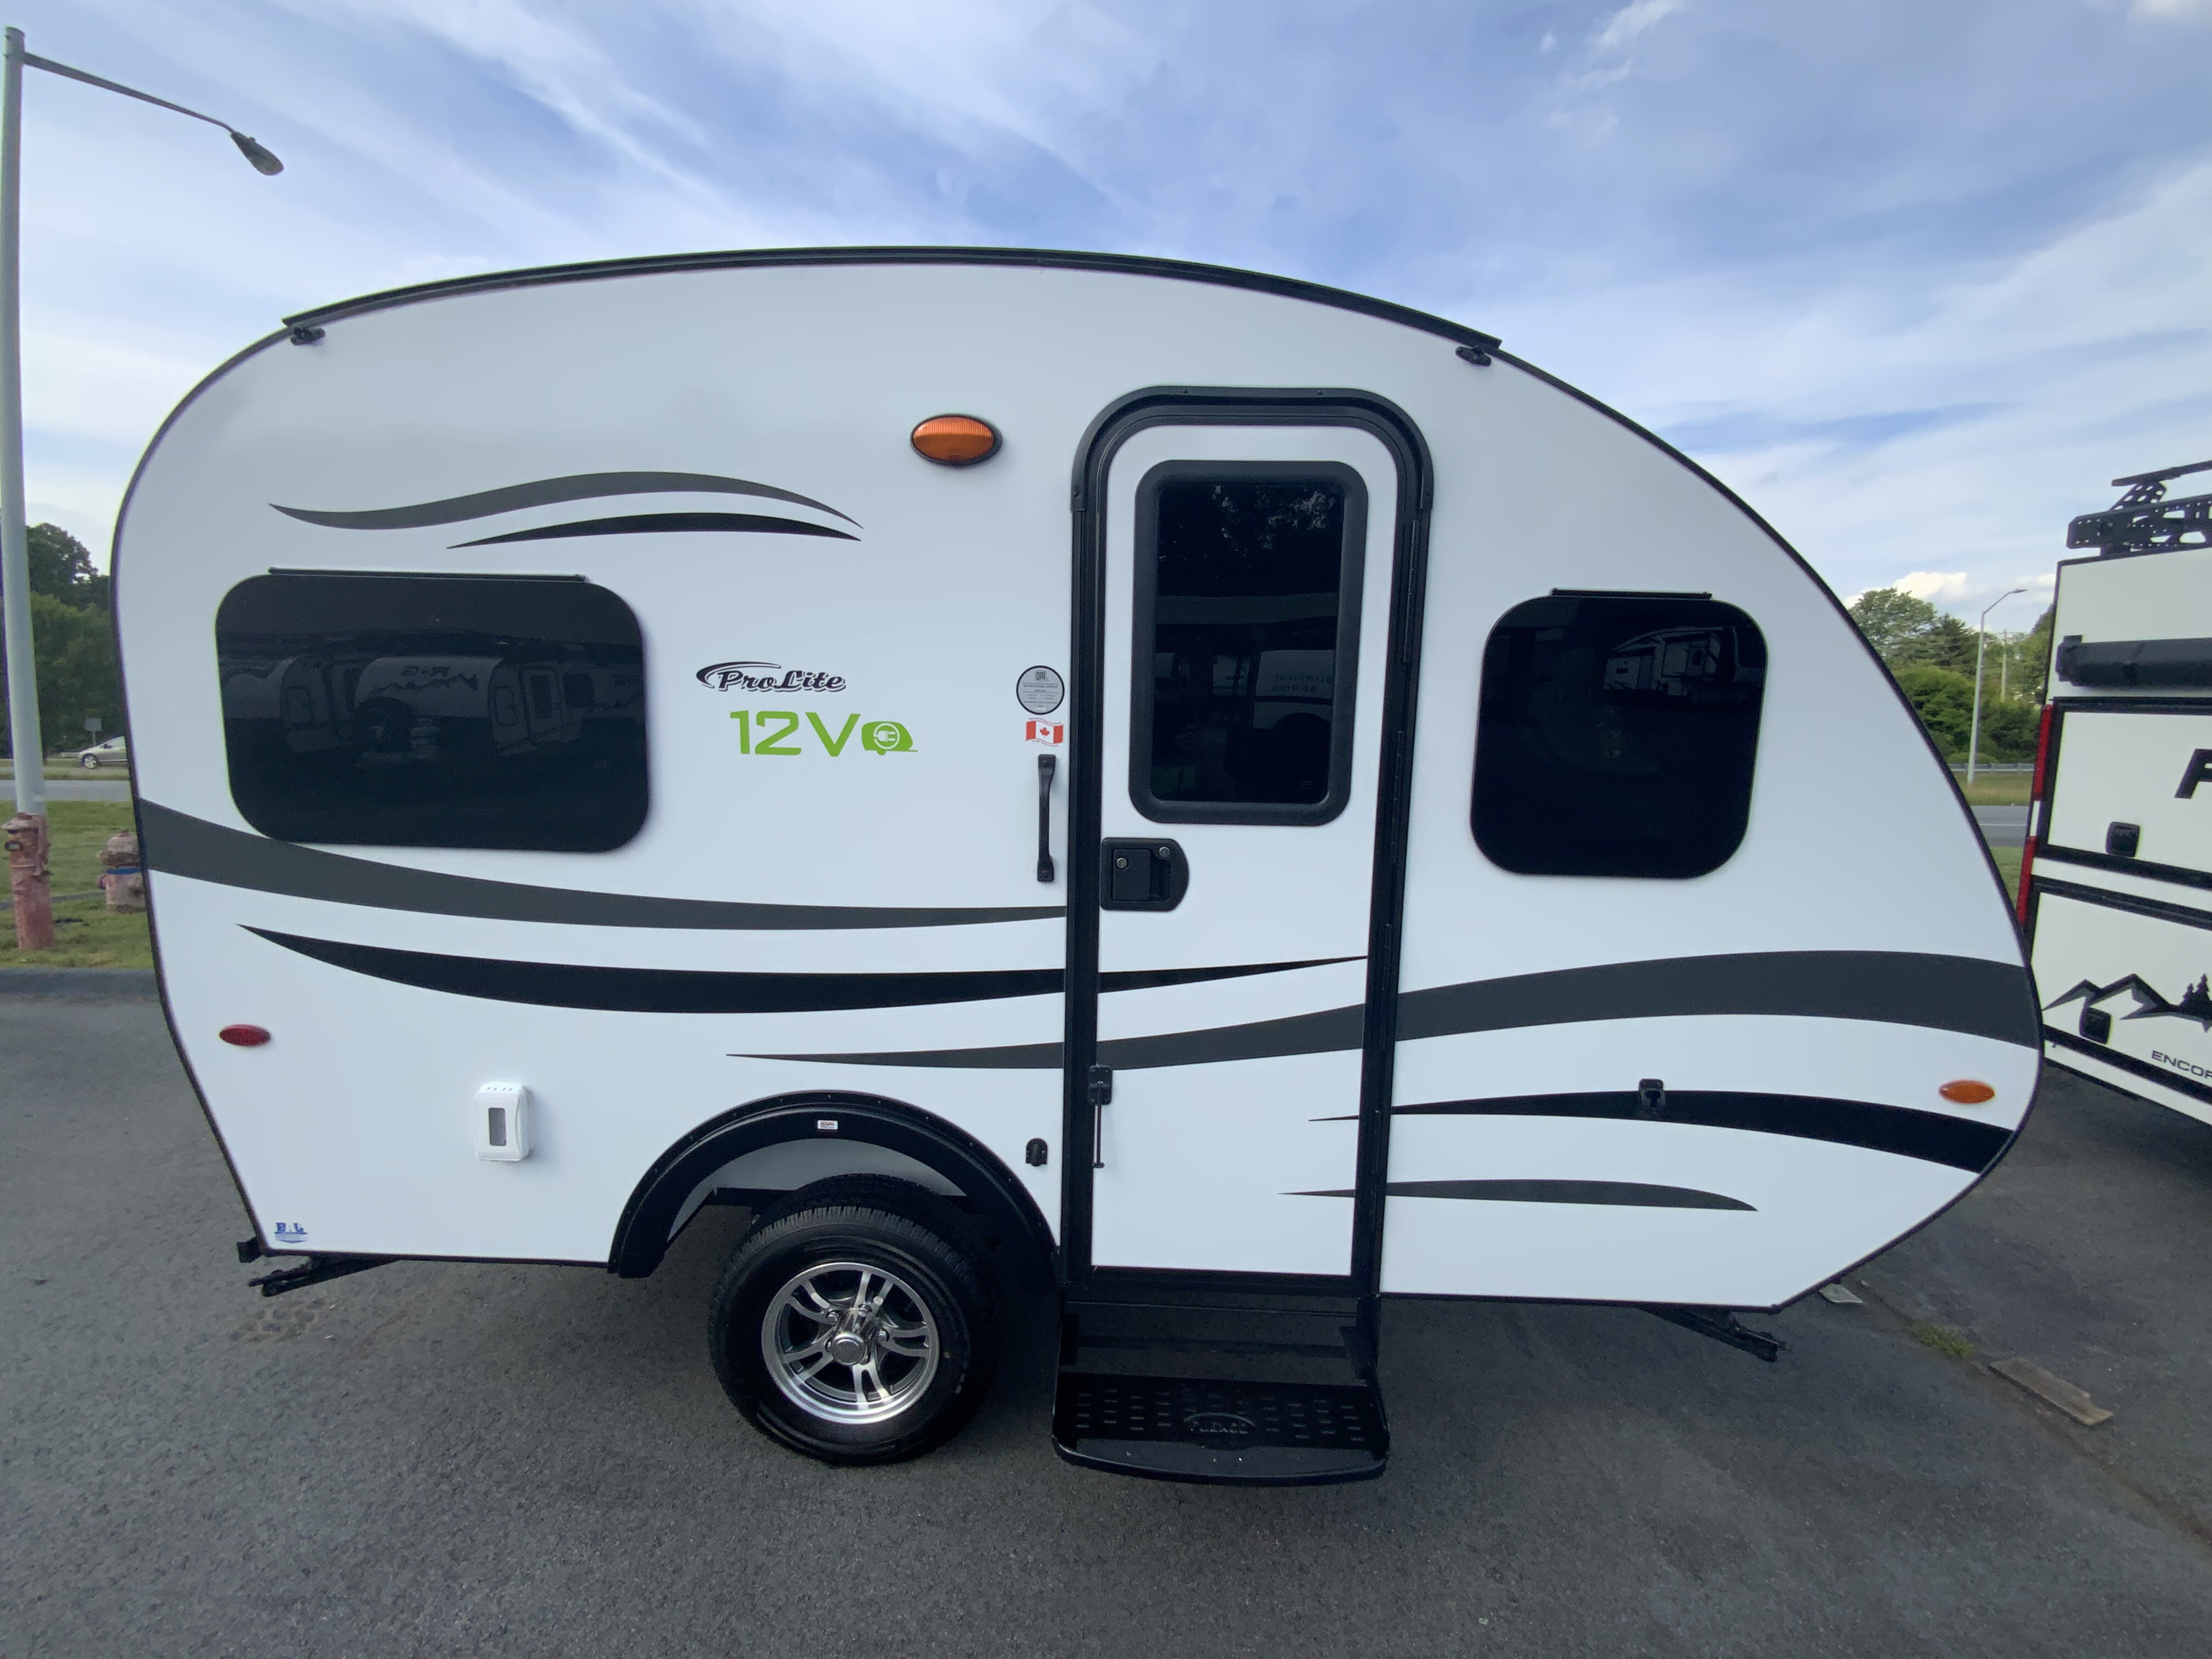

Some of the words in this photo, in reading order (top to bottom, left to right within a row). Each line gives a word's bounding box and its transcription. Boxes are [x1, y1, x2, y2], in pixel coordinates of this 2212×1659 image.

[714, 669, 846, 693] ProLite
[1035, 671, 1046, 680] QAI
[730, 710, 861, 758] 12V
